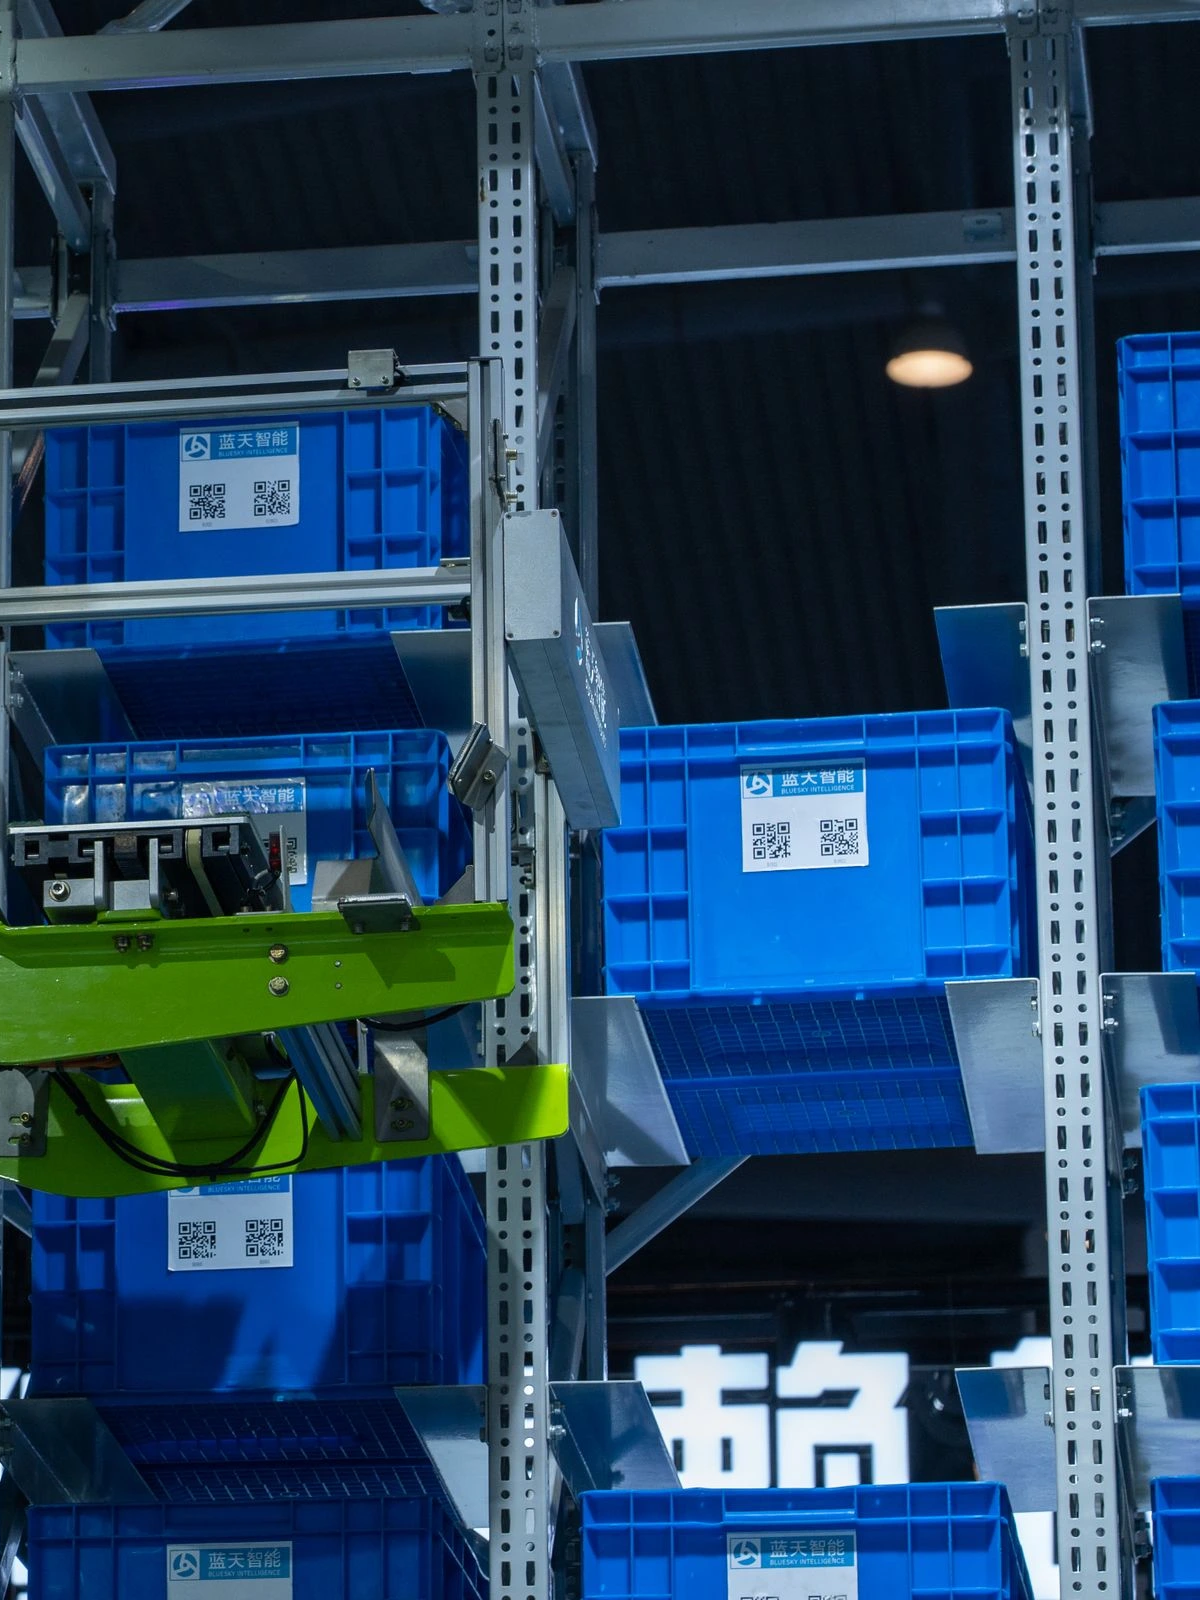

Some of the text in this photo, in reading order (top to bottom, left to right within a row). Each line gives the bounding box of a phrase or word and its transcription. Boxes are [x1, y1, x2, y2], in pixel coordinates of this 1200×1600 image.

[218, 430, 289, 450] 蓝天智能
[781, 785, 855, 795] BLUESKY INTELLIGENCE
[769, 1538, 845, 1558] 蓝天智能
[208, 1548, 281, 1570] 蓝天智能
[769, 1557, 845, 1566] BLUESKY INTELLIGENCE
